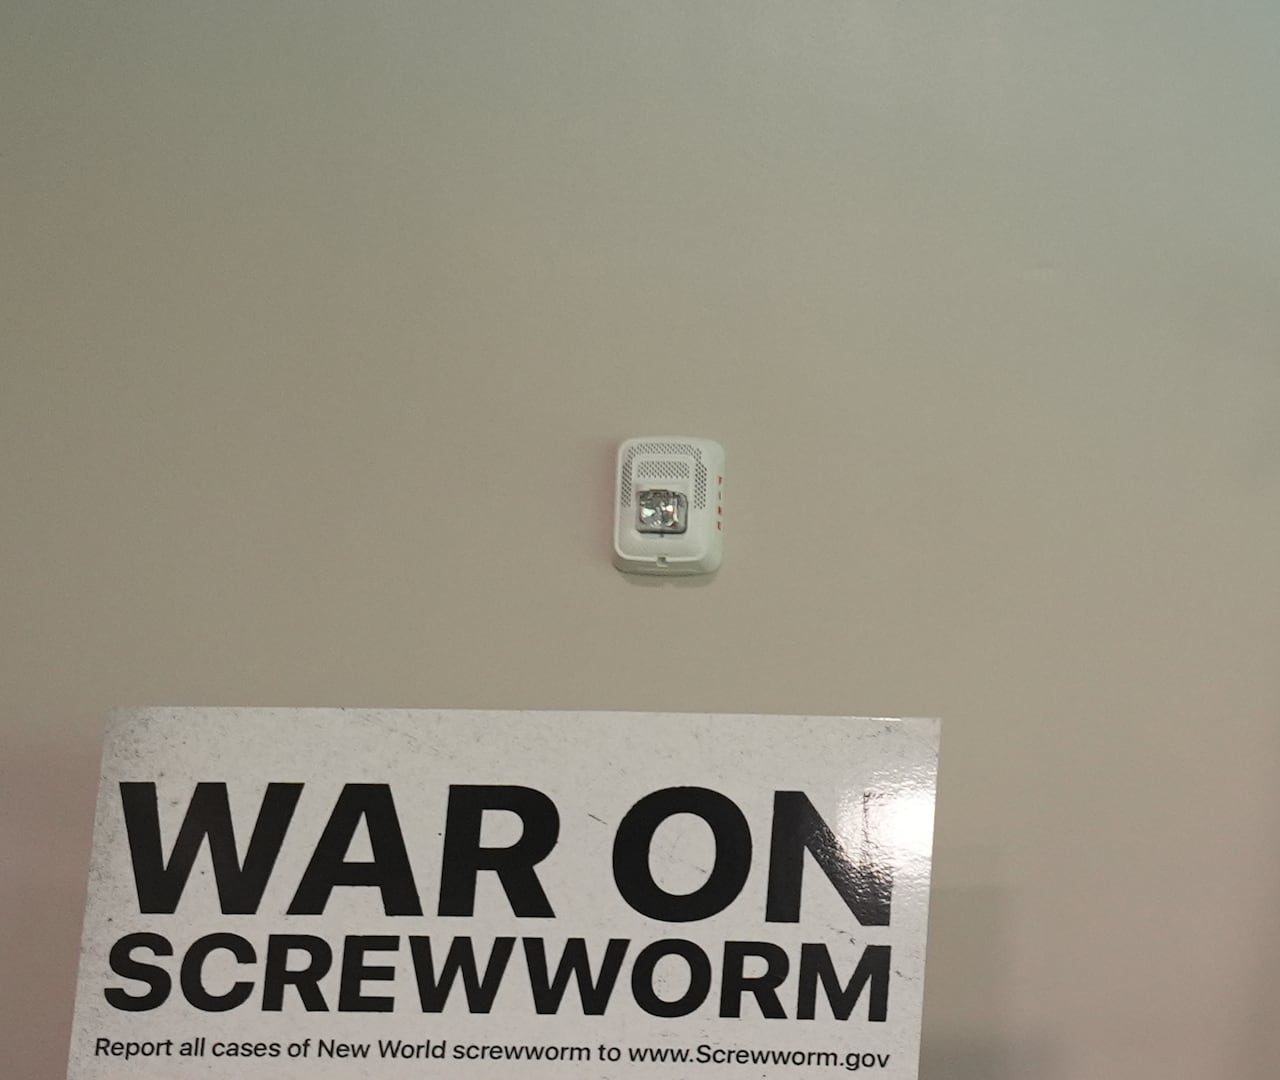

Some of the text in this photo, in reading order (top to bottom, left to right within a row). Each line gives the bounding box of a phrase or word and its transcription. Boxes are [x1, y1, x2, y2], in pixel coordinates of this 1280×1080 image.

[119, 782, 892, 927] WAR ON
[104, 932, 892, 1023] SCREWWORM
[94, 1037, 891, 1072] Report all cases of New World screwworm to www.Screwworm.gov
